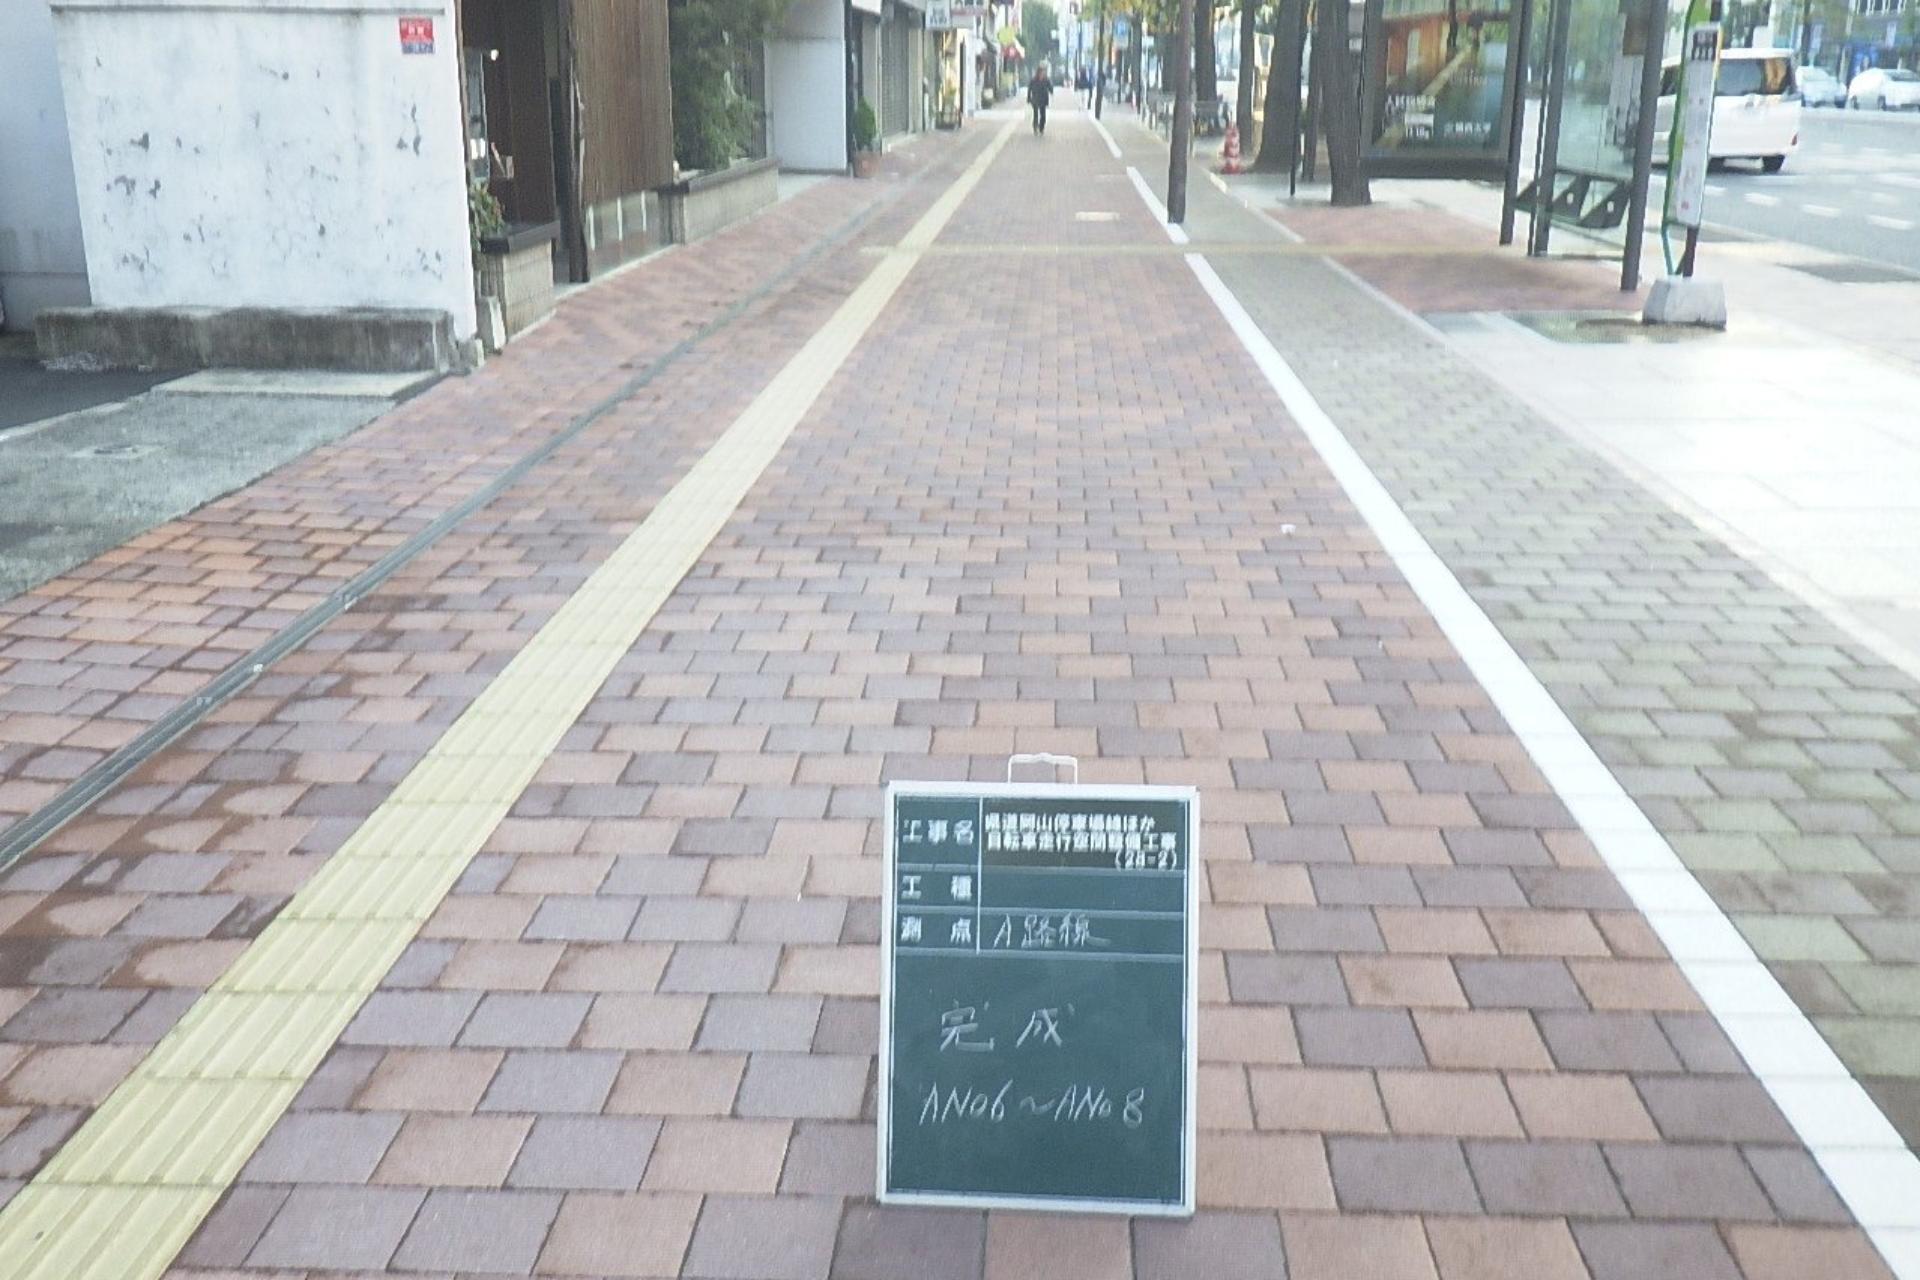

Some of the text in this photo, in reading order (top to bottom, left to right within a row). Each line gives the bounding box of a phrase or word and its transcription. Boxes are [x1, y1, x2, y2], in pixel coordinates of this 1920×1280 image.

[902, 819, 974, 845] 工事名
[901, 875, 972, 901] 工種
[901, 916, 972, 942] 測点
